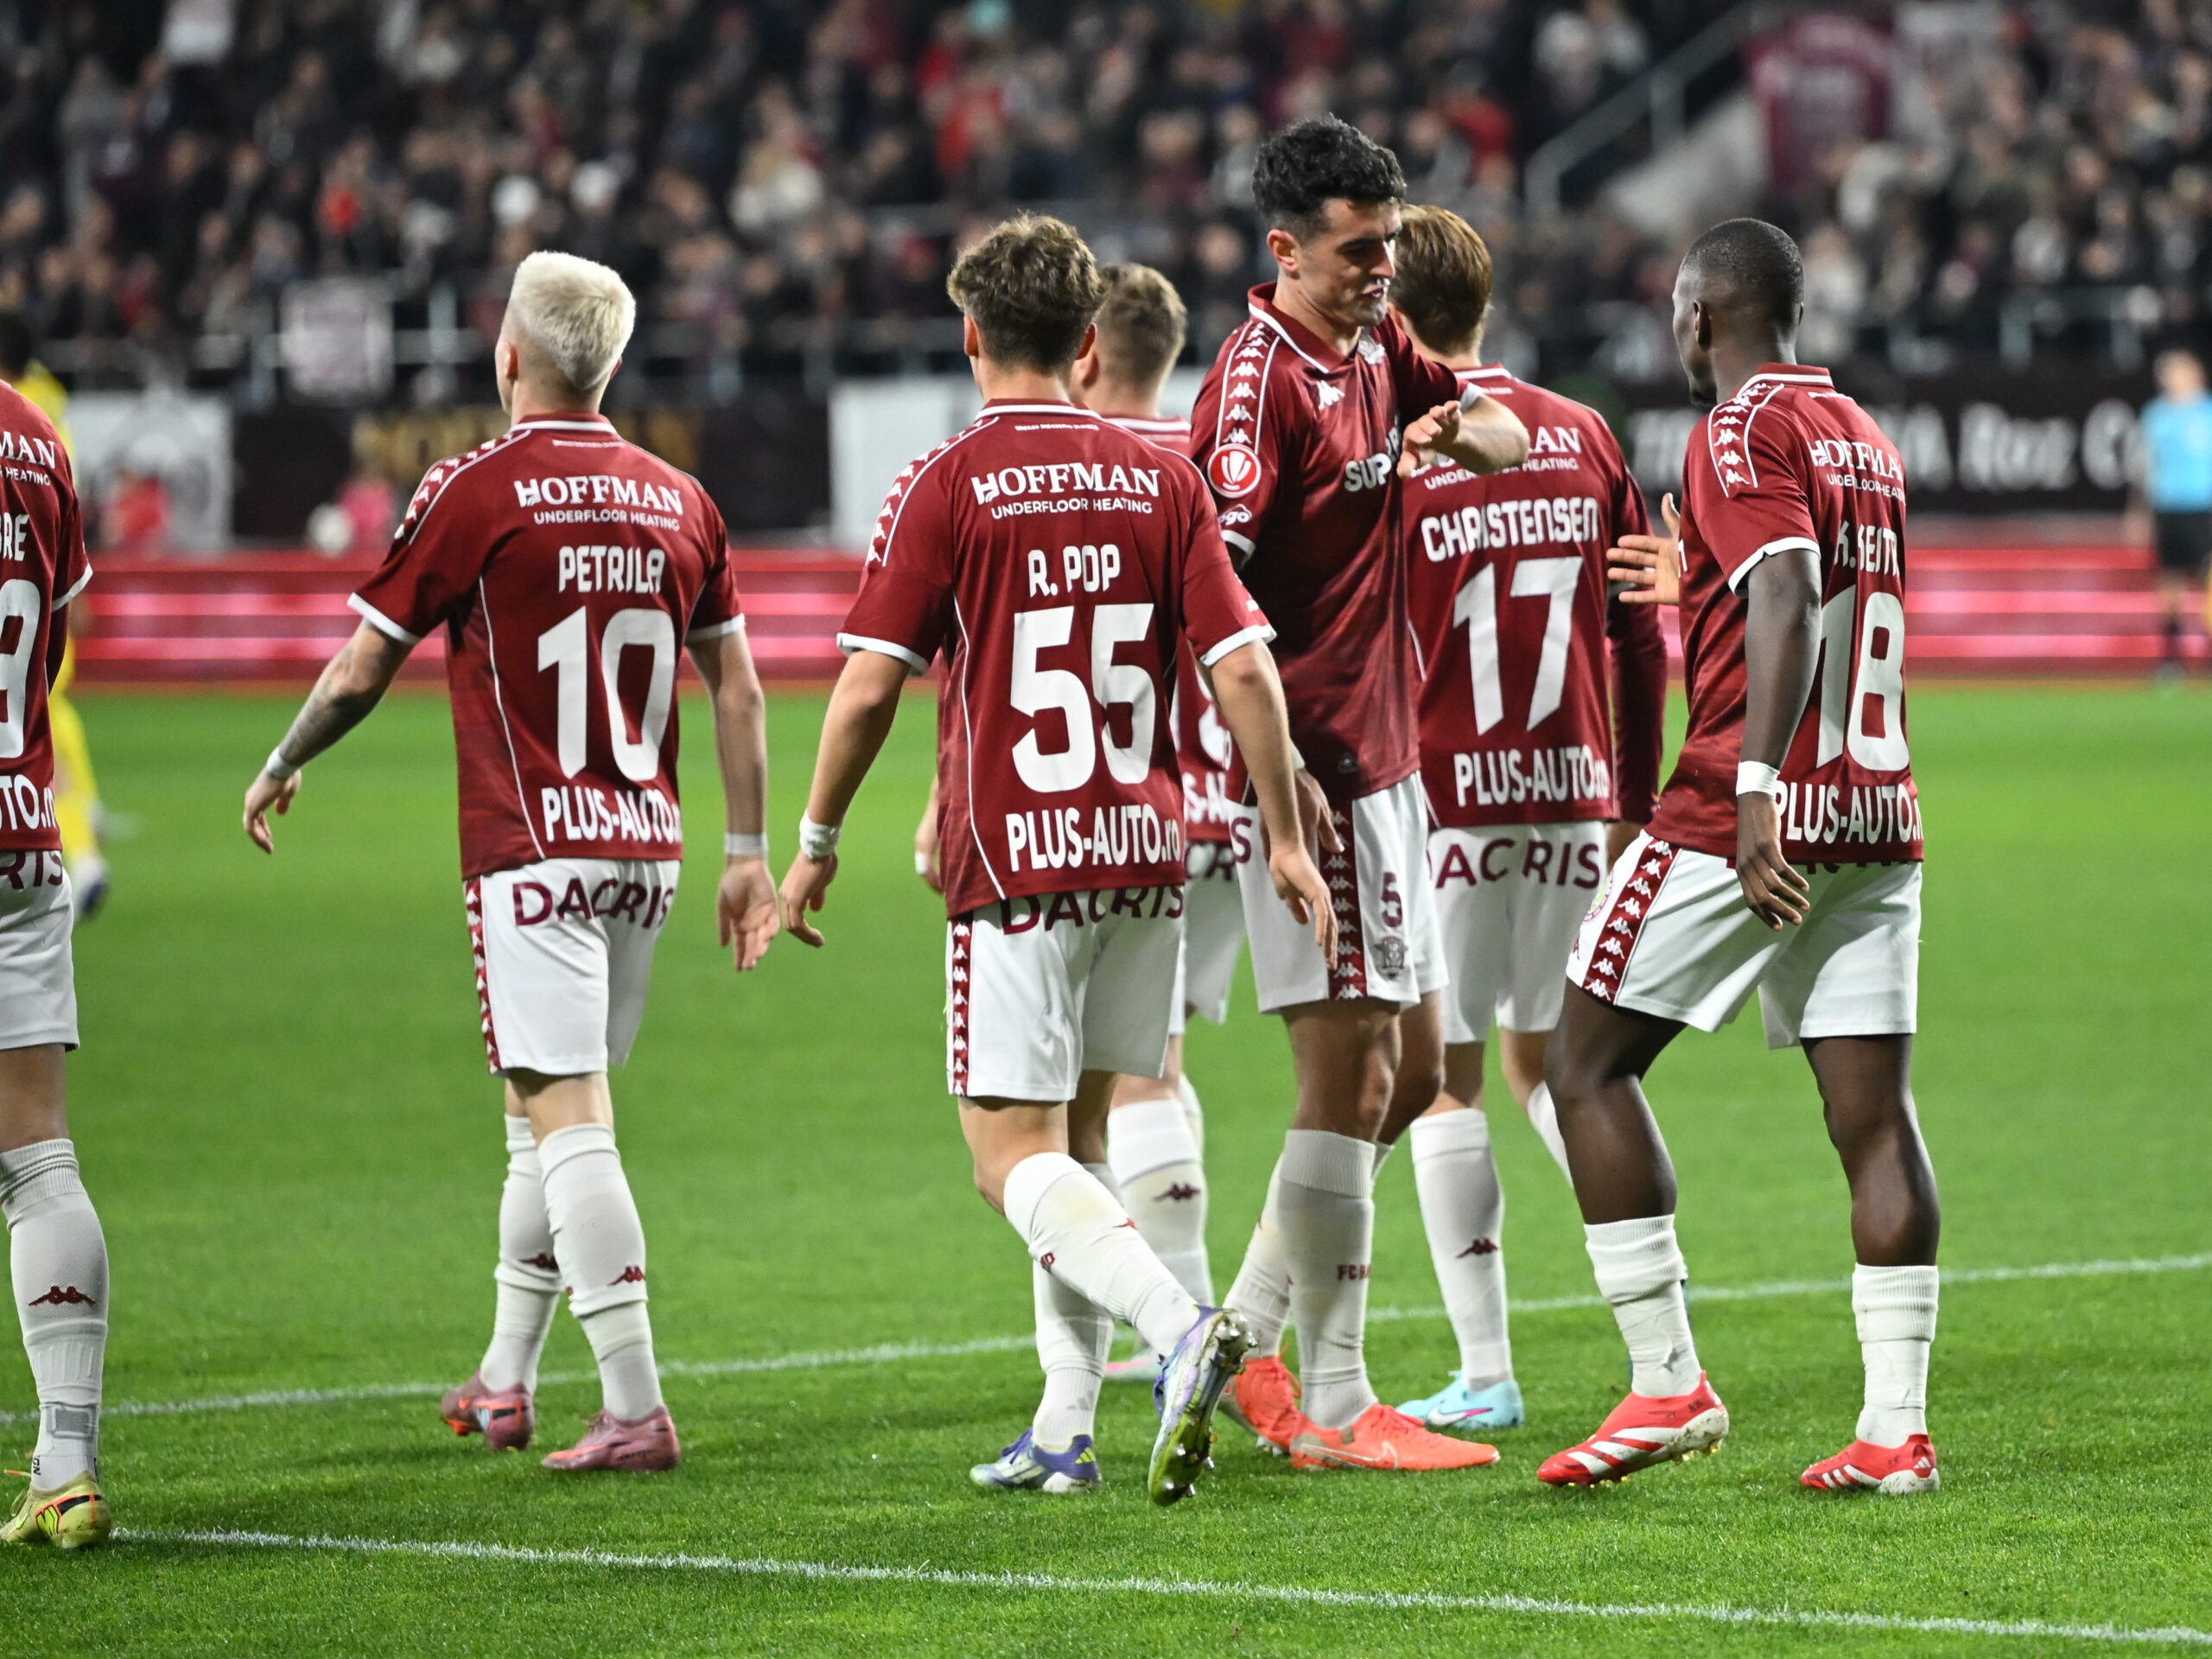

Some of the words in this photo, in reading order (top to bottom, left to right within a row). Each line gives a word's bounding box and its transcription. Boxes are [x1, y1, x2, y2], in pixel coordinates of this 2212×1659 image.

[5, 467, 51, 486] HEATING
[514, 476, 683, 516] HOFFMAN
[971, 462, 1160, 505] HOFFMAN
[534, 510, 627, 524] UNDERFLOOR
[631, 512, 680, 532] HEATING
[991, 498, 1088, 520] UNDERFLOOR
[1093, 497, 1153, 514] HEATING
[1421, 497, 1599, 563] CHRISTENSEN
[559, 545, 665, 594] PETRILA
[1028, 550, 1058, 597] R.
[1063, 544, 1120, 594] POP
[1453, 556, 1584, 735] 17
[537, 605, 676, 781] 10
[1010, 603, 1156, 792] 55
[1816, 584, 1910, 771] 18
[1005, 803, 1180, 873] PLUS-AUTO.ro
[1427, 837, 1599, 890] ACRIS
[512, 878, 674, 930] DACRIS
[1000, 884, 1184, 935] DACRIS
[1380, 872, 1402, 927] 5
